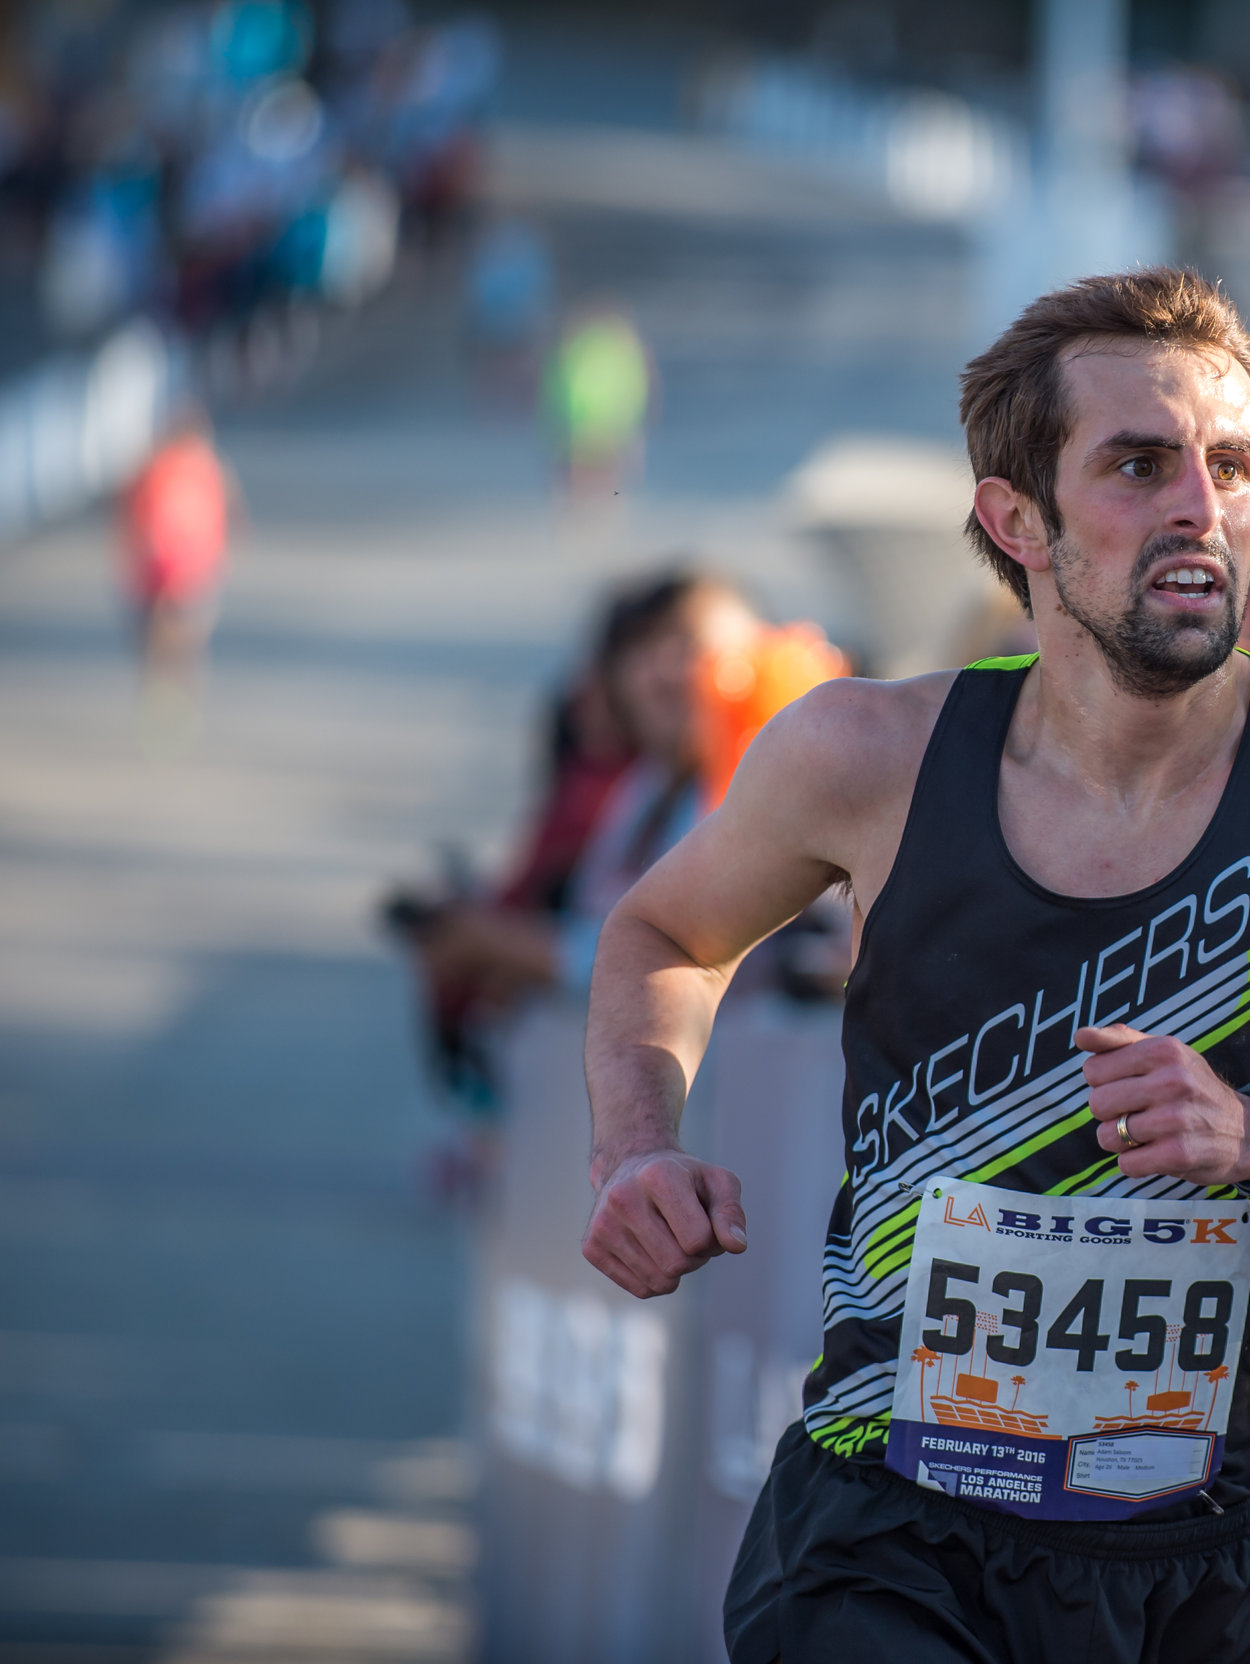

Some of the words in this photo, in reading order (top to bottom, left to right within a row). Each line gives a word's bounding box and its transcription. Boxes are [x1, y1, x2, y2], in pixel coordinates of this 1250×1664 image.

[943, 1196, 992, 1233] LA
[995, 1227, 1074, 1243] SPORTING
[1079, 1235, 1133, 1245] GOODS
[922, 1257, 1234, 1372] 53458
[921, 1436, 990, 1456] FEBRUARY
[1016, 1449, 1047, 1464] 2016
[928, 1462, 972, 1474] SKECHERS
[973, 1467, 1043, 1482] PERFORMANCE
[961, 1473, 984, 1485] LOS
[988, 1476, 1042, 1492] ANGELES
[960, 1484, 1041, 1503] MARATHON
